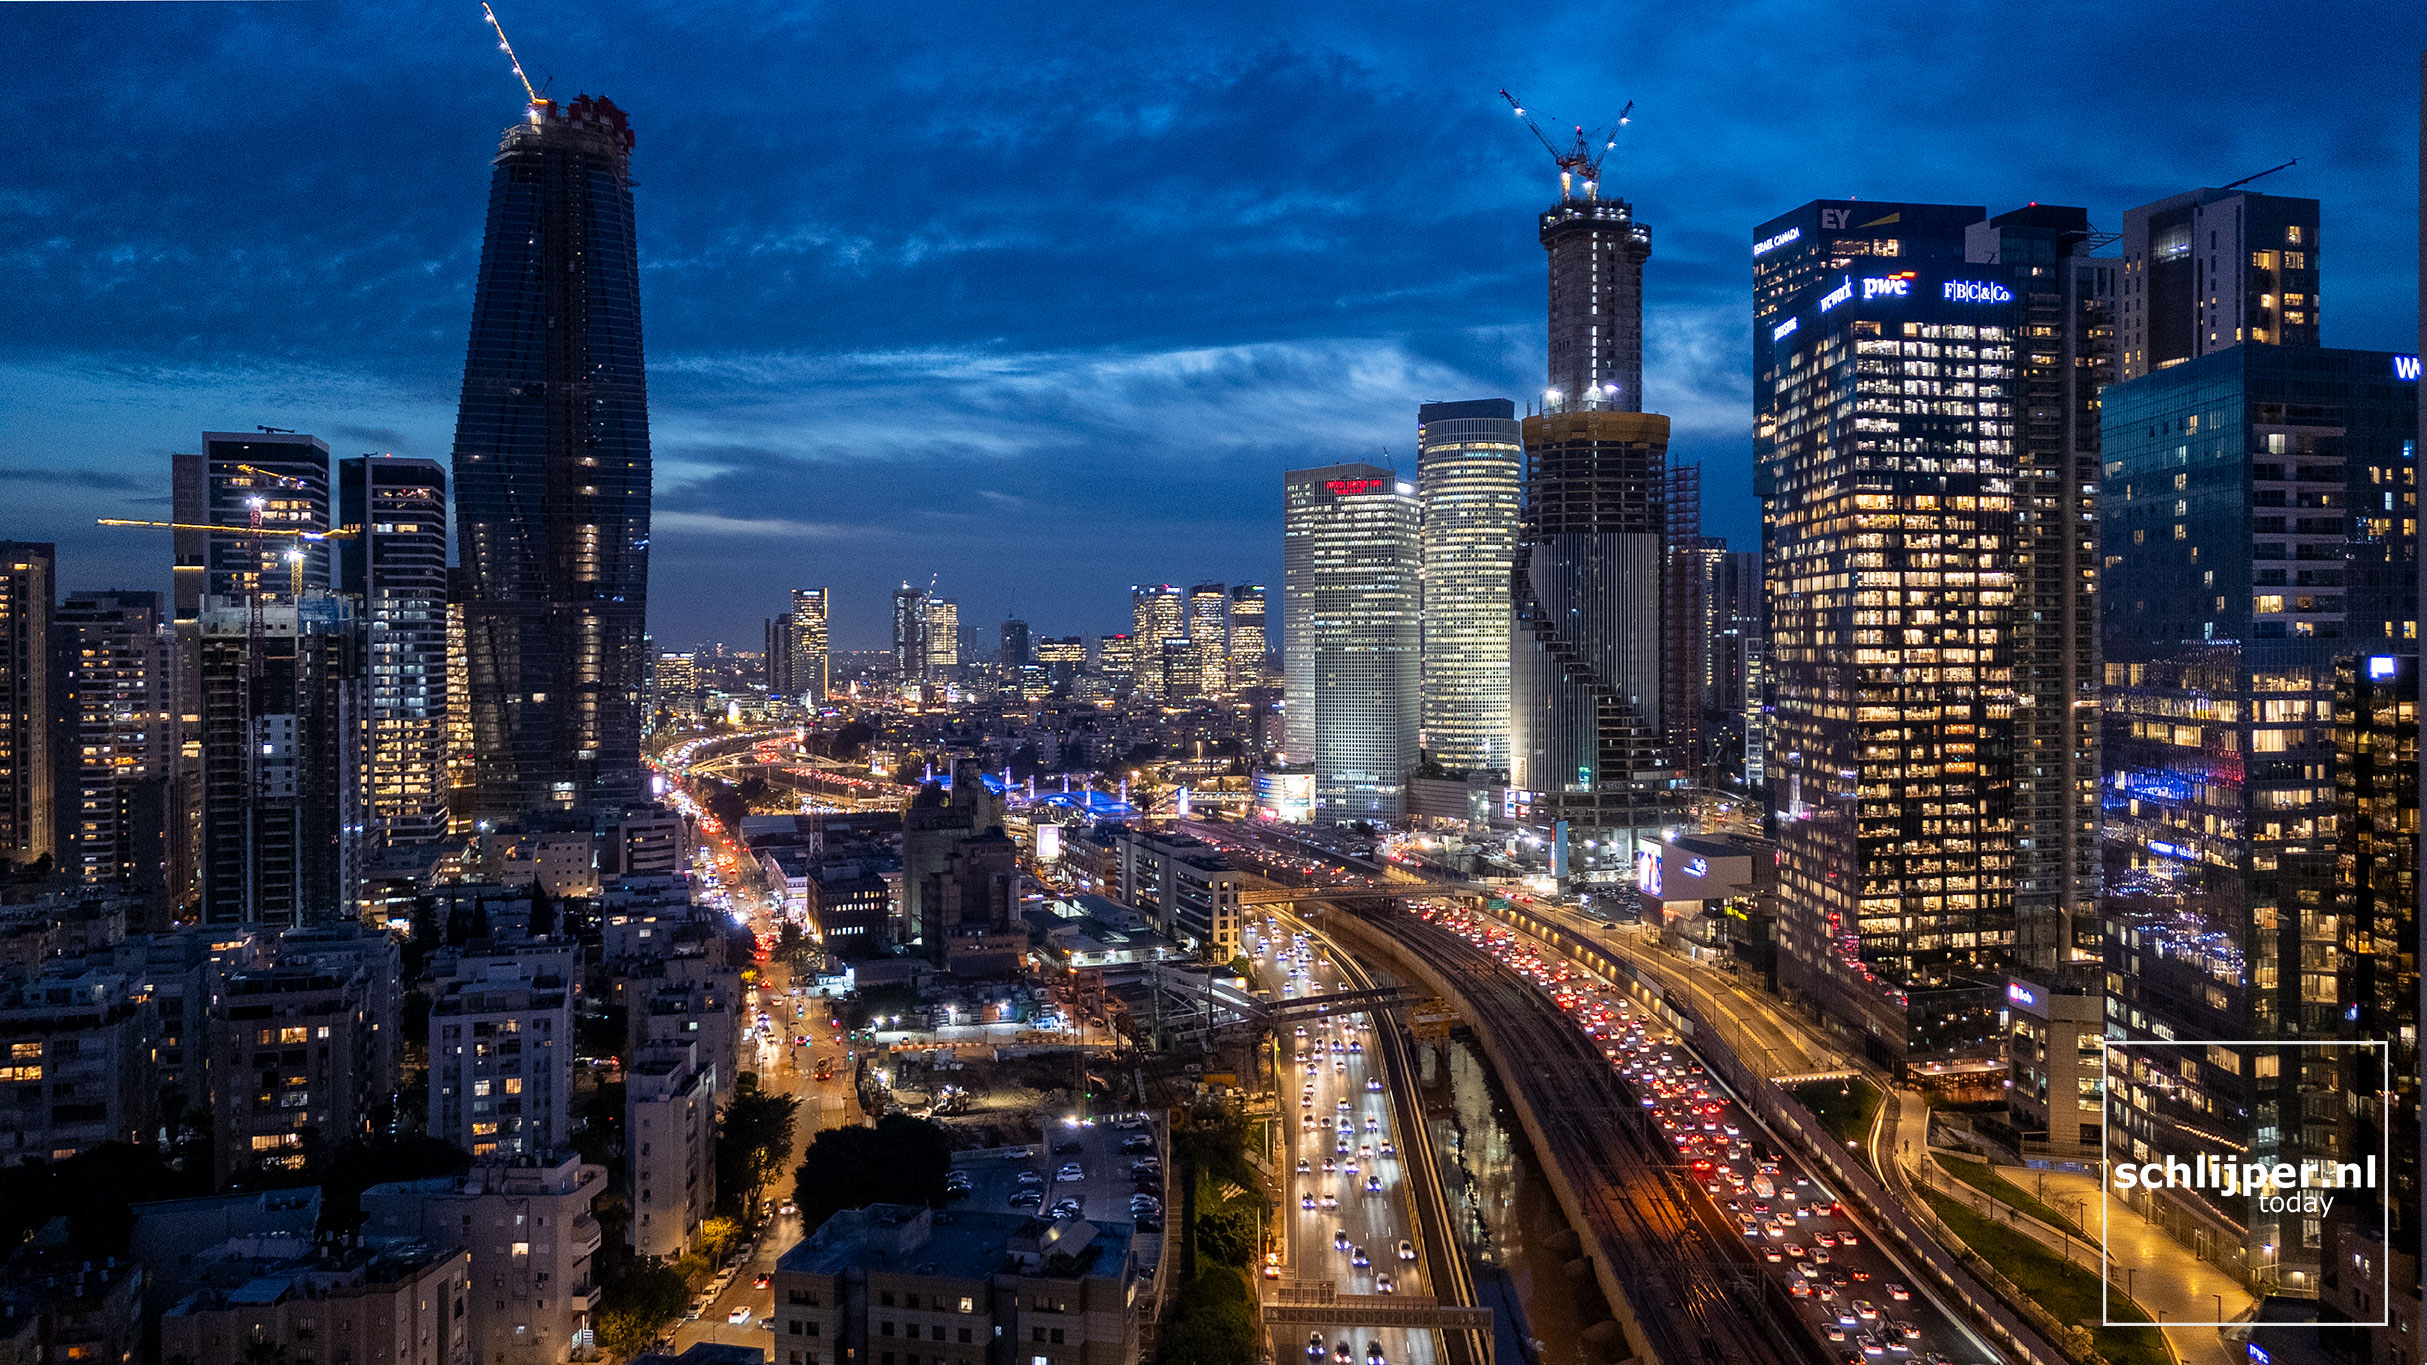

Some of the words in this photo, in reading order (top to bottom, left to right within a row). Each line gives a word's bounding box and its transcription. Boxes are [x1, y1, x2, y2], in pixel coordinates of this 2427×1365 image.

[1822, 209, 1851, 229] EY
[1753, 238, 1774, 256] ISRAEL
[1774, 226, 1800, 246] CANADA
[1863, 277, 1908, 299] pwc
